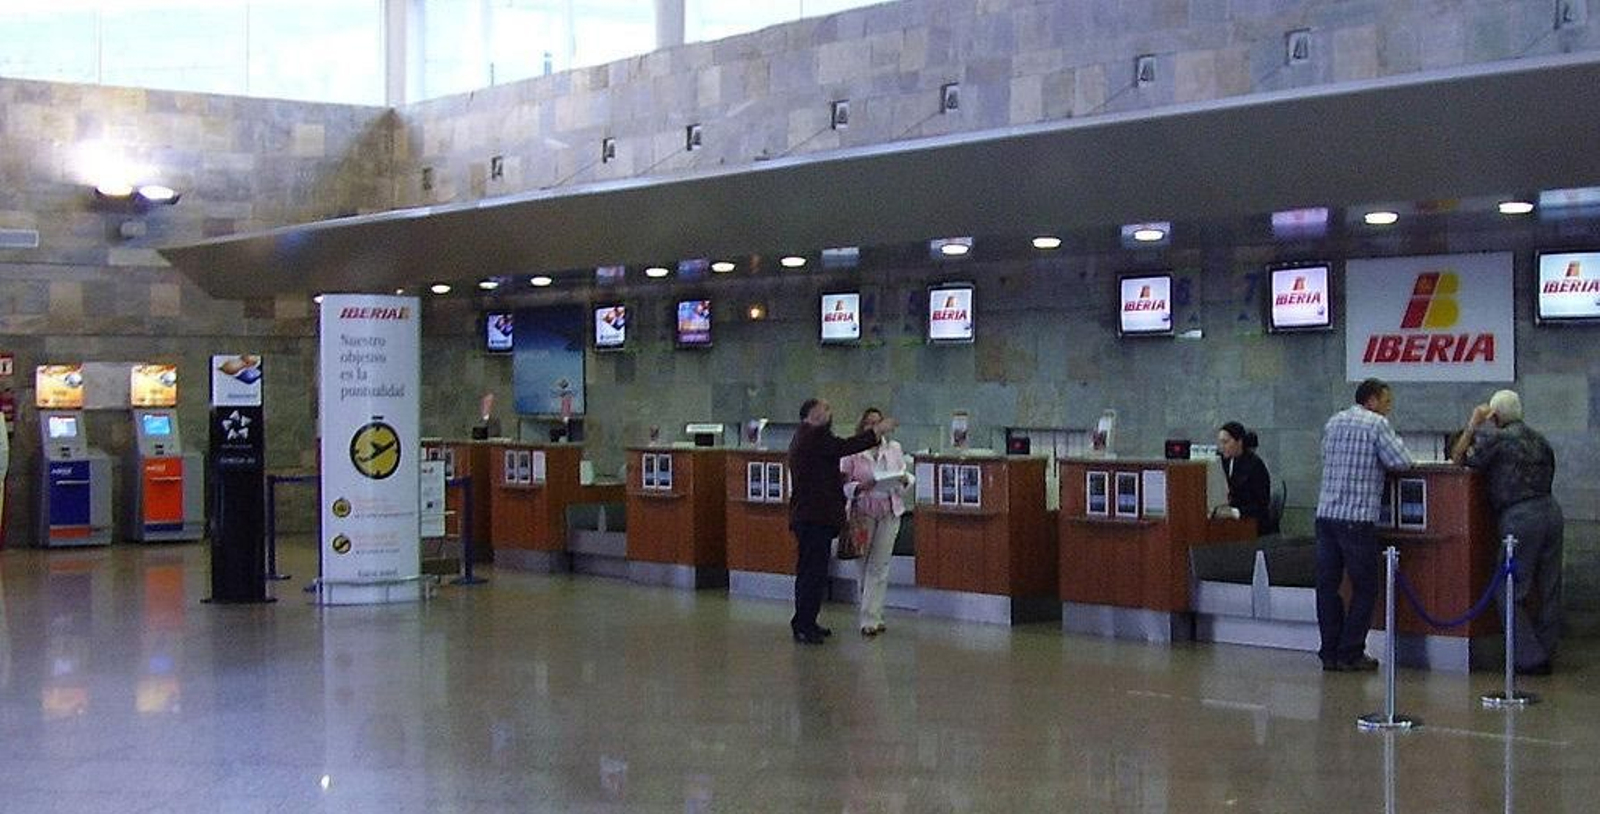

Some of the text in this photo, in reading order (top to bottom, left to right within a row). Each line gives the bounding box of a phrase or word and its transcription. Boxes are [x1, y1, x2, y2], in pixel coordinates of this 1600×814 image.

[1543, 280, 1600, 294] IBERIA
[1275, 292, 1321, 305] IBERIA
[1124, 300, 1166, 312] IBERIA
[340, 307, 398, 320] IBERIA
[824, 312, 854, 322] IBERIA
[933, 309, 967, 321] IBERIA
[340, 334, 387, 347] Nuestro
[1363, 333, 1495, 364] IBERIA
[340, 367, 368, 380] es la
[340, 384, 405, 401] puntualidad
